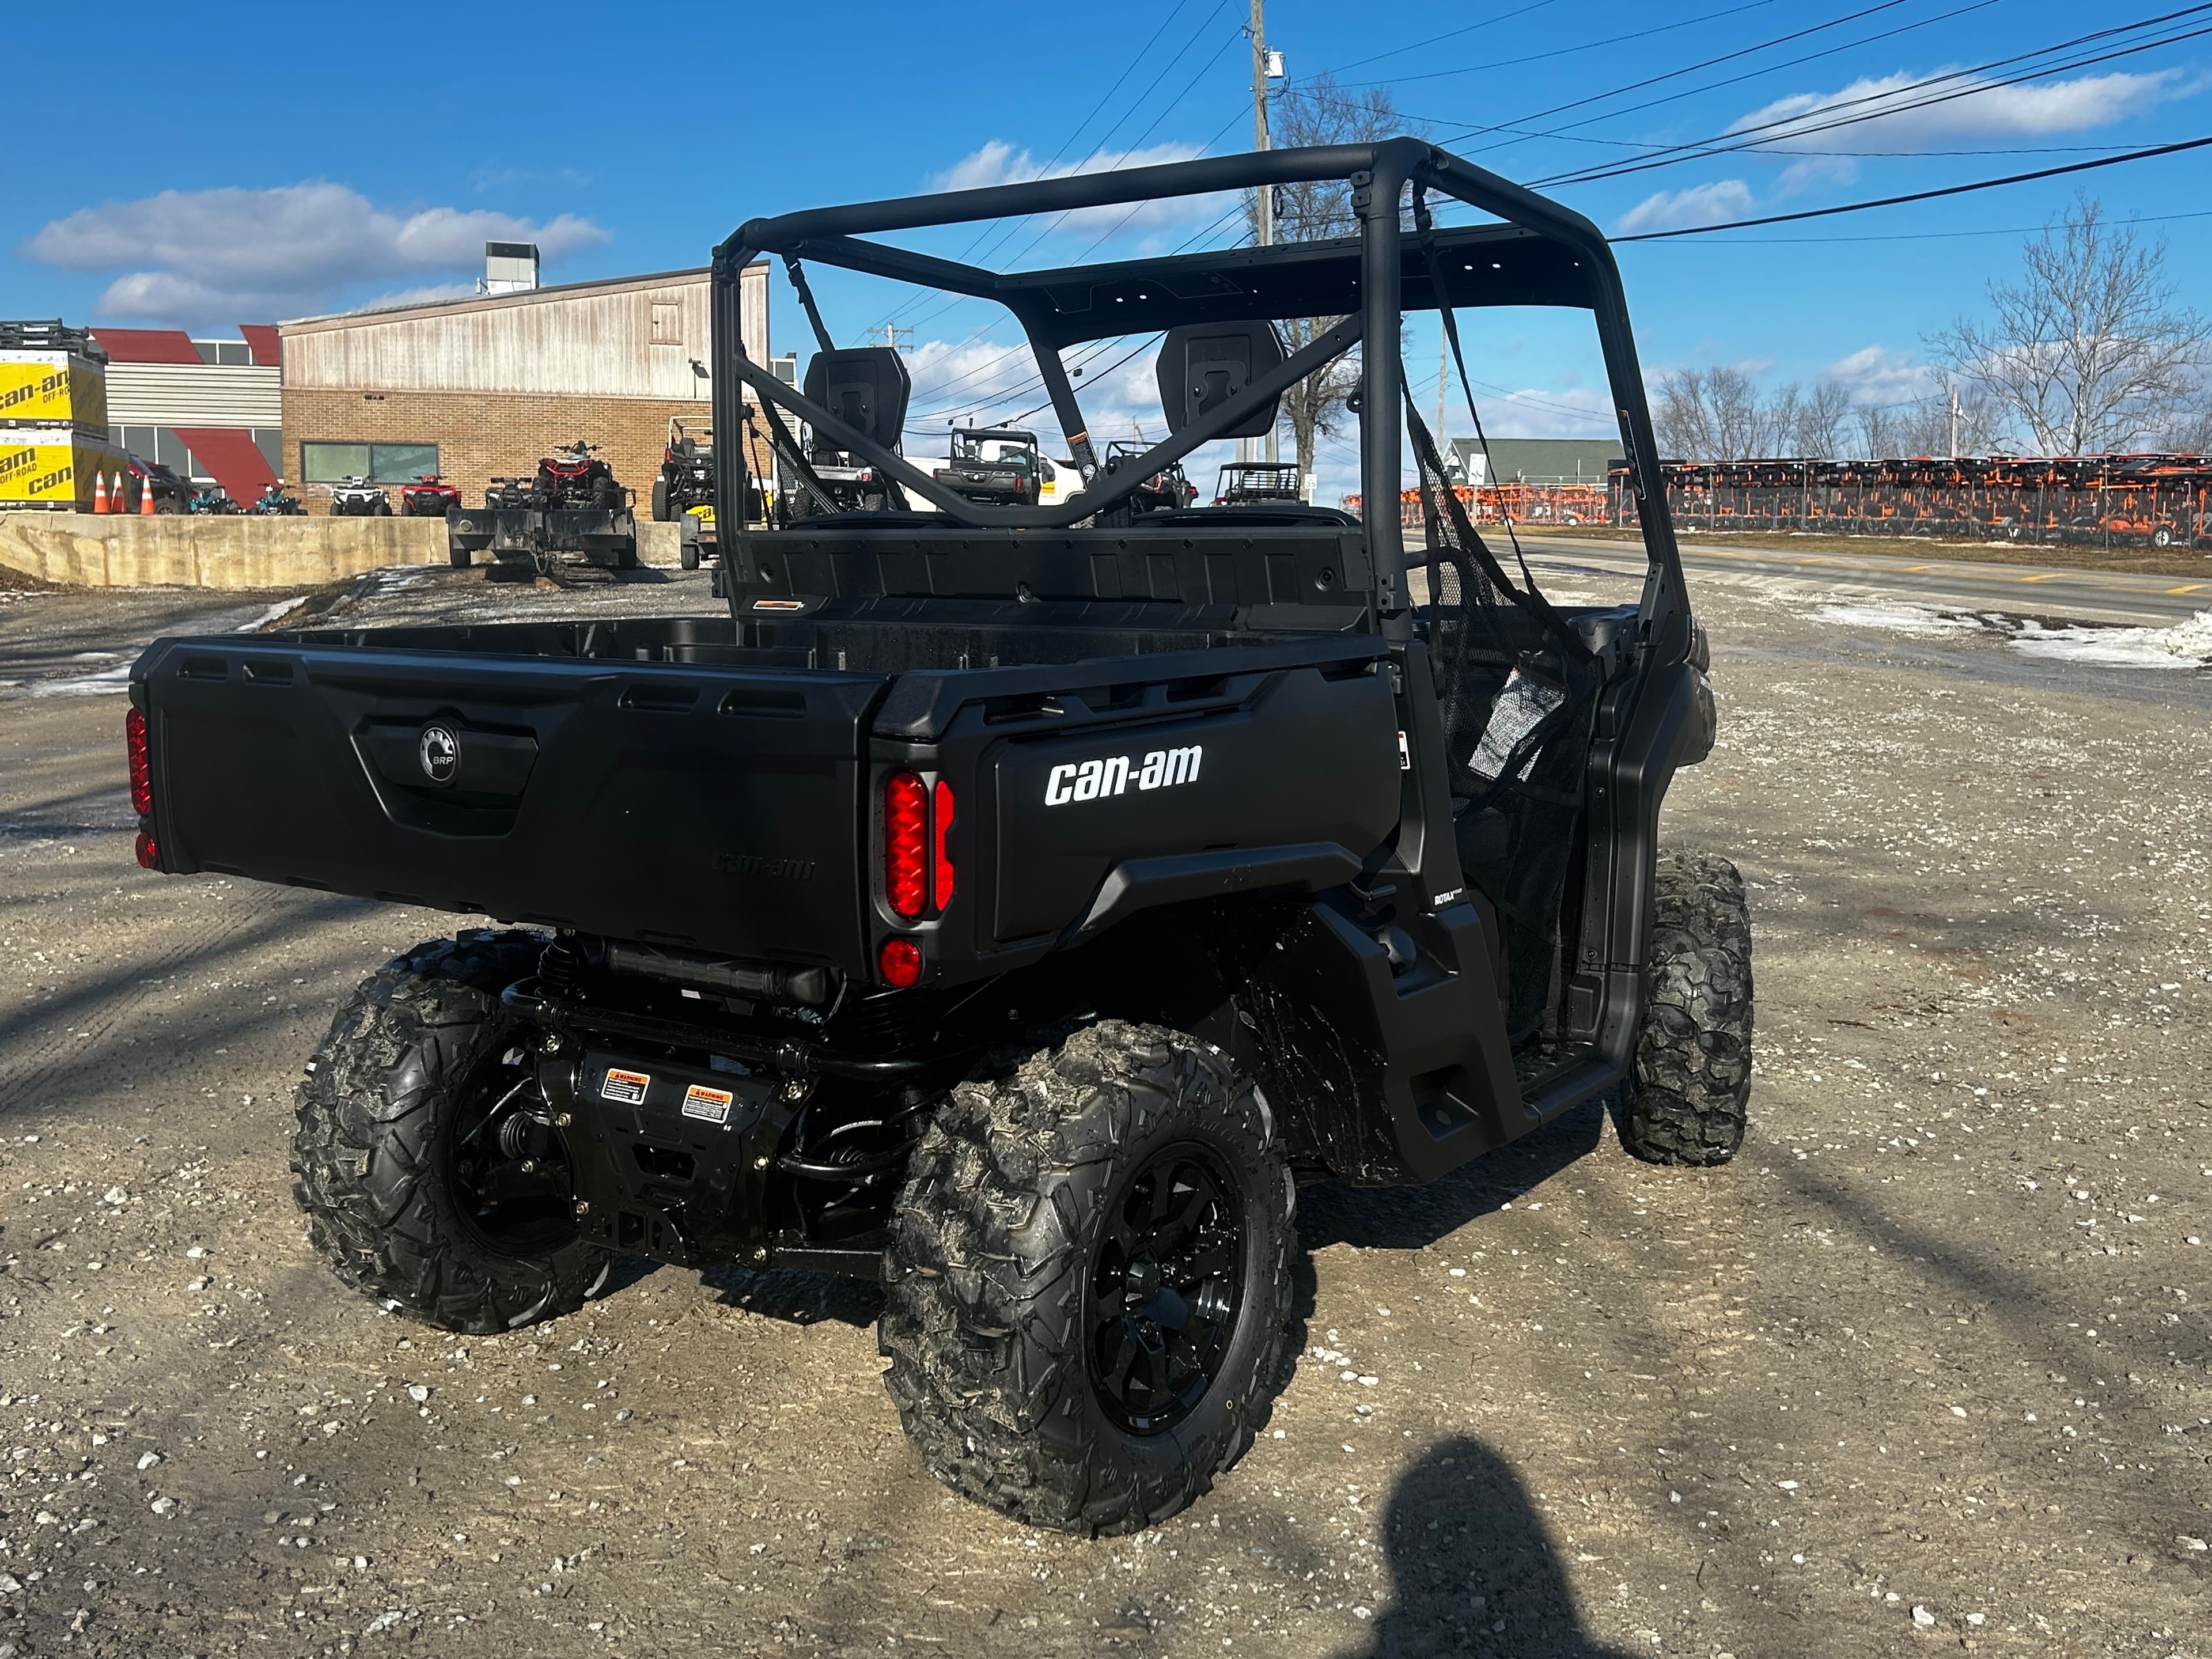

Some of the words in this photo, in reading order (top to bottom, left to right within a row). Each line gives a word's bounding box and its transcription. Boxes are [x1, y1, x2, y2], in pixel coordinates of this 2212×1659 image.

[0, 370, 69, 410] an-a
[433, 756, 453, 765] BRP
[1044, 745, 1203, 806] can-am
[1434, 891, 1455, 906] ROTAX
